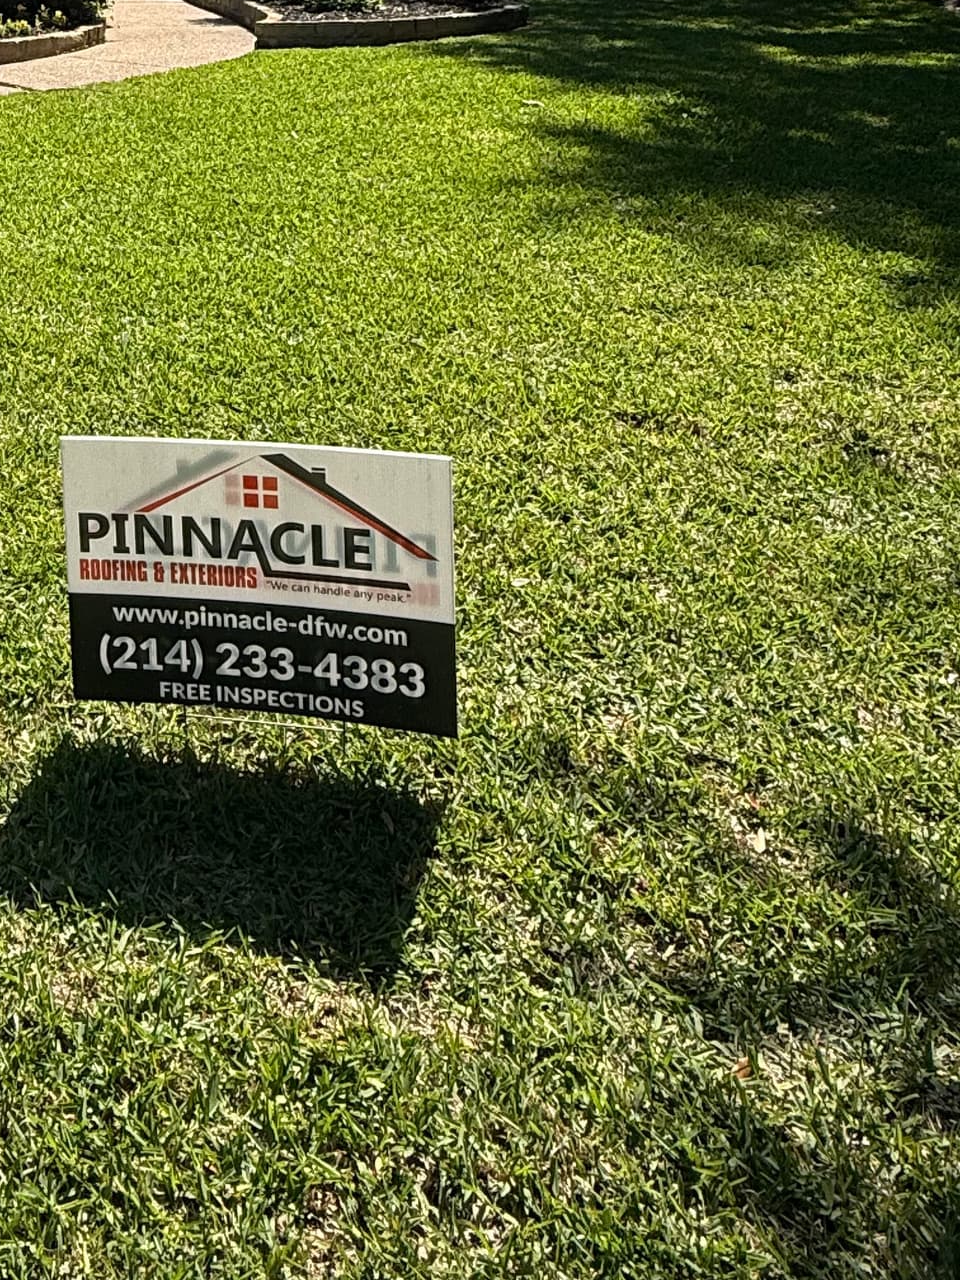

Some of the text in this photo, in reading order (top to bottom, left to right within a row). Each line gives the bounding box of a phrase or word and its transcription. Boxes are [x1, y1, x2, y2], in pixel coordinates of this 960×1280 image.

[78, 512, 372, 571] PINNACLE
[79, 558, 257, 589] ROOFING & EXTERIORS
[291, 583, 310, 593] can
[313, 584, 351, 597] handle
[353, 590, 373, 601] any
[112, 605, 408, 647] www.pinnacle-dfw.com
[99, 632, 426, 699] (214) 233-4383
[159, 681, 365, 718] FREE INSPECTIONS
